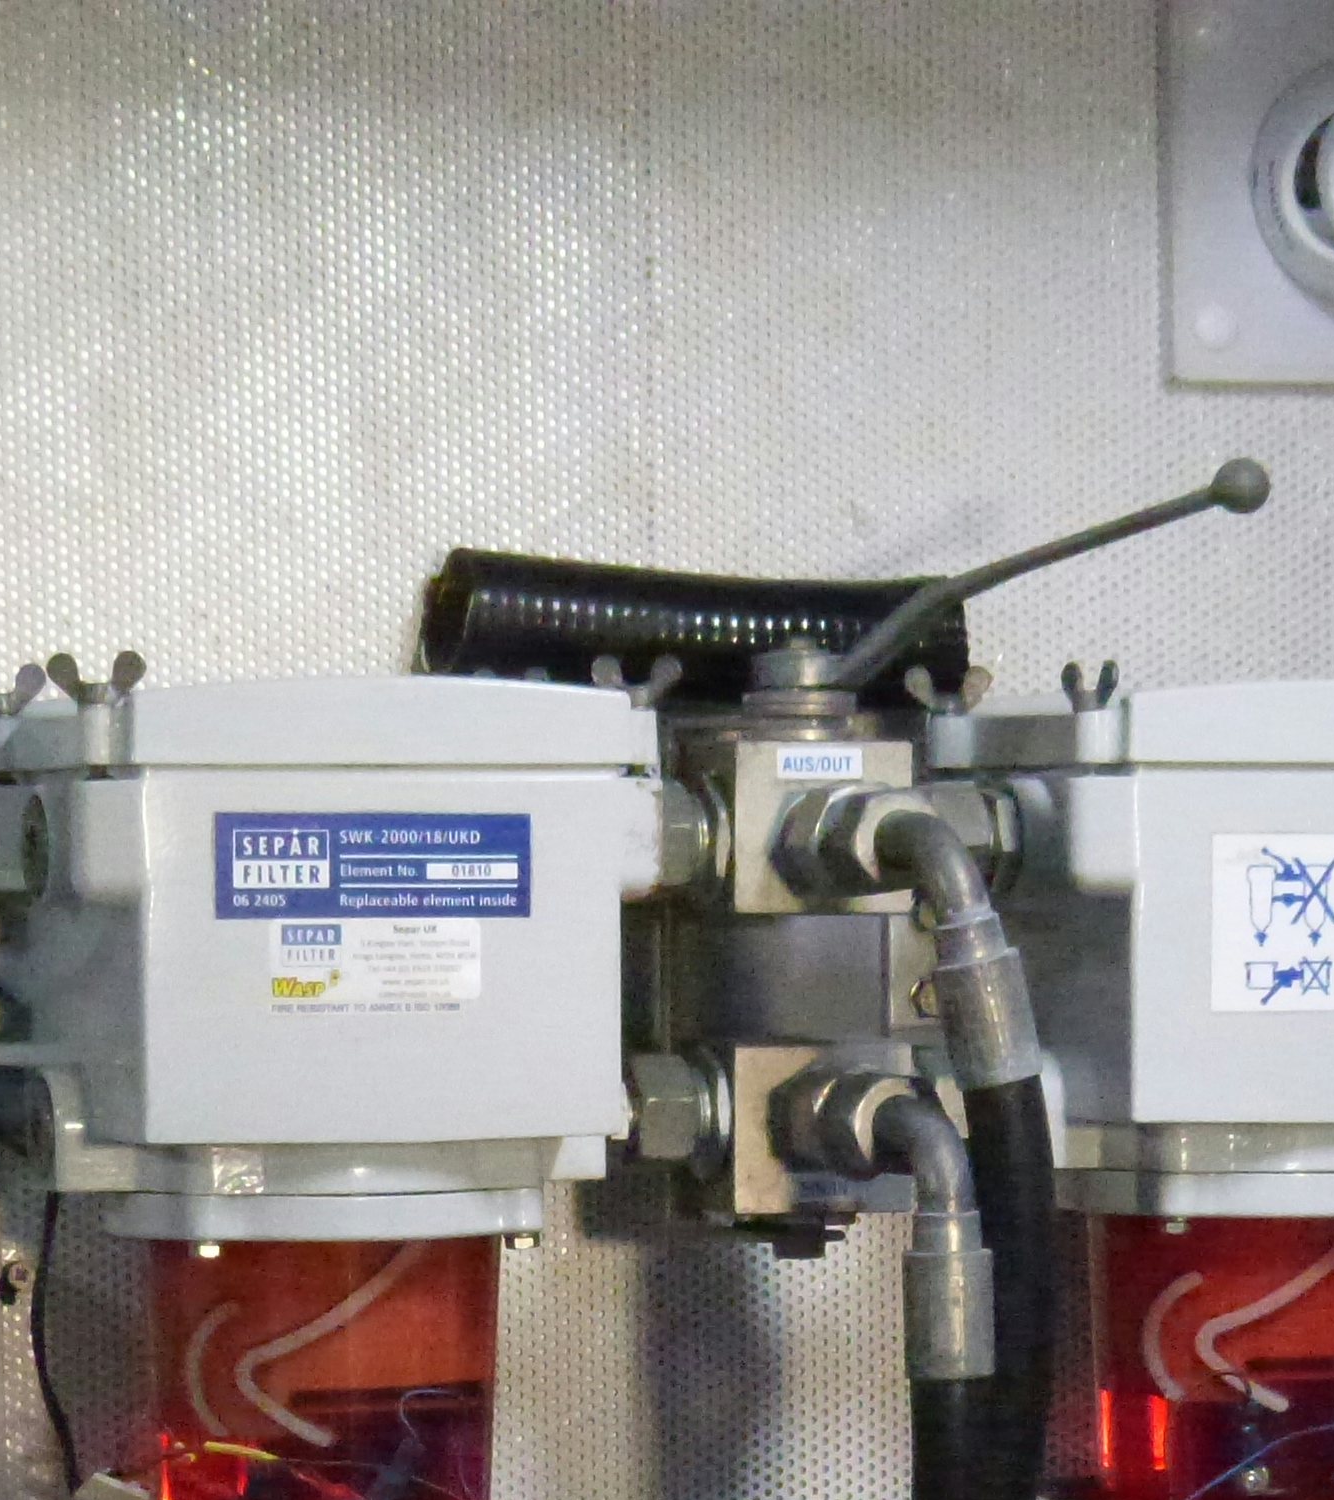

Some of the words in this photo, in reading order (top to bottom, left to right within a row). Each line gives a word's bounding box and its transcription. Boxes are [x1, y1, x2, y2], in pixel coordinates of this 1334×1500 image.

[782, 755, 853, 773] AUS/OUT
[242, 864, 320, 884] FILTER
[339, 862, 394, 878] Element
[397, 863, 419, 878] No.
[451, 864, 492, 879] 01810
[232, 893, 250, 908] 06
[253, 893, 287, 908] 2405
[339, 892, 419, 909] Replaceable
[422, 892, 476, 907] element
[478, 892, 518, 907] inside
[286, 928, 336, 943] SEPAR
[286, 948, 336, 962] FILTER
